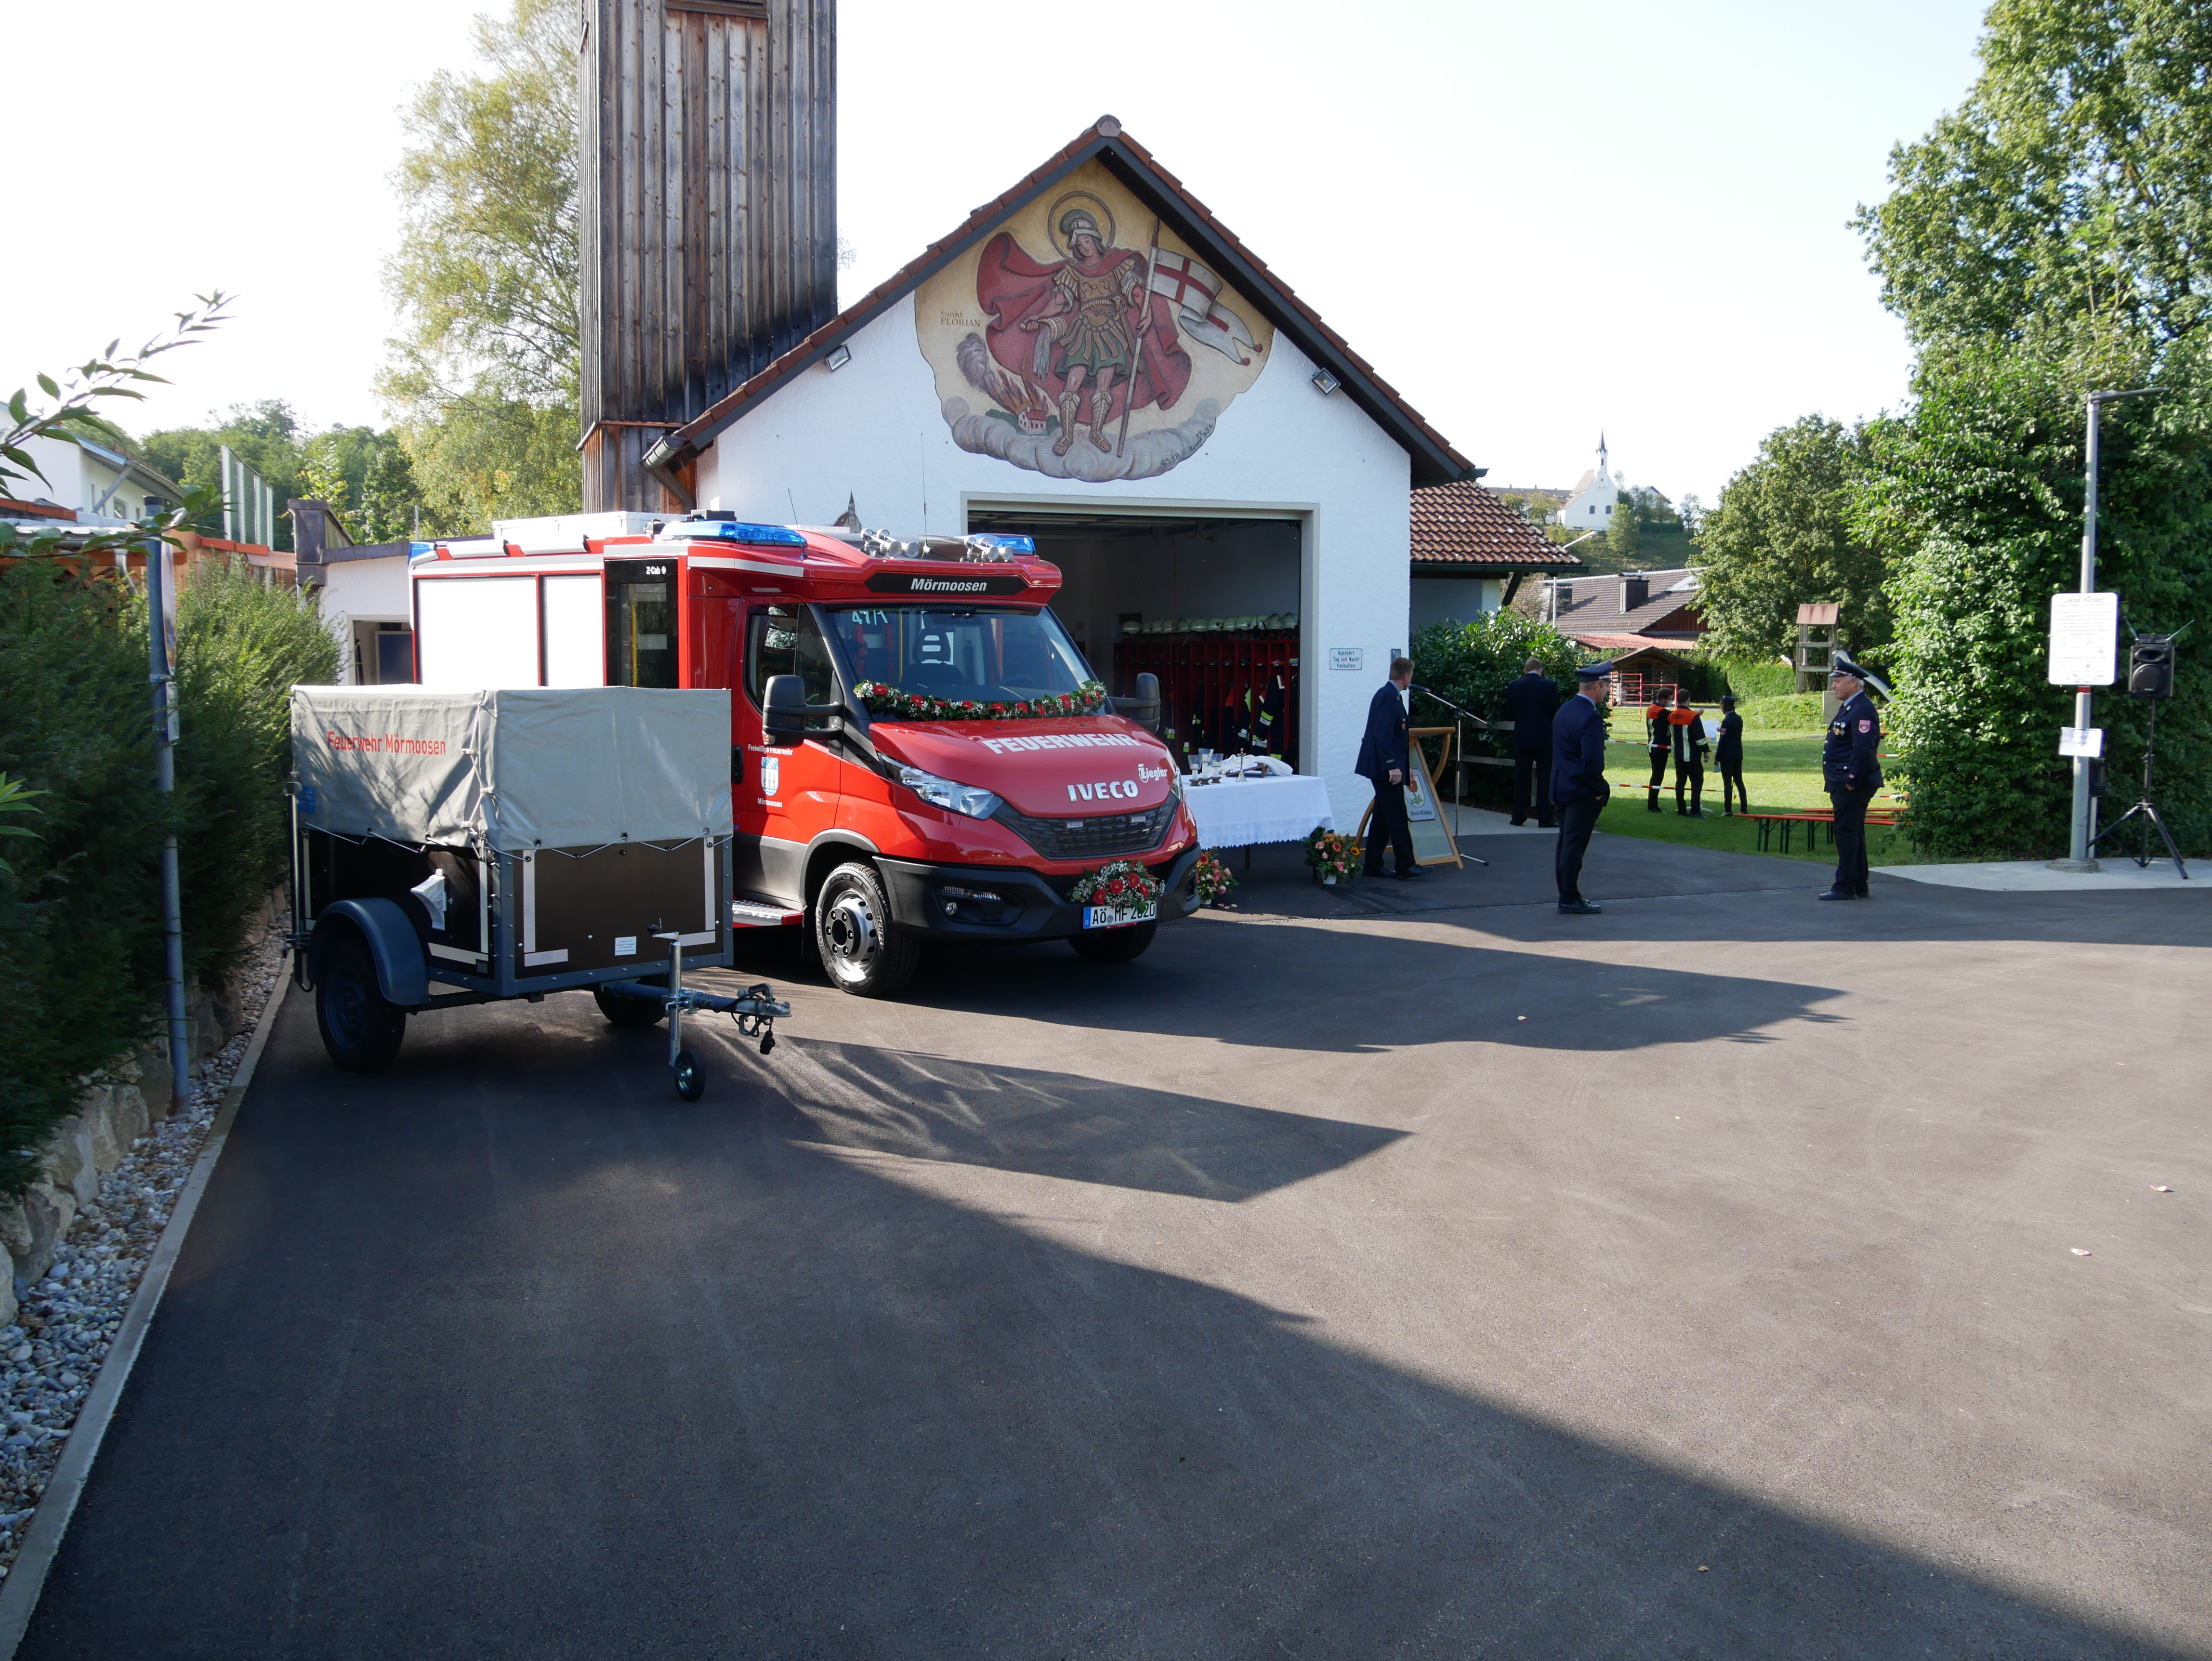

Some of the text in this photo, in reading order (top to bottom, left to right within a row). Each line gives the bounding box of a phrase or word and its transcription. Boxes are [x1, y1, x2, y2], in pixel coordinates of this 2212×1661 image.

[940, 310, 962, 318] Sankt
[941, 317, 980, 327] FLORIAN
[646, 566, 660, 575] Z-Cab
[910, 578, 988, 592] Mörmoosen
[328, 731, 446, 756] Feuerwehr Mörmoosen
[748, 744, 794, 756] Freiwillige Feuerwehr
[982, 733, 1142, 754] FEUERWEHR
[1067, 780, 1138, 802] IVECO
[757, 797, 783, 808] Mörmoosen
[1092, 908, 1106, 924] AÖ
[1114, 906, 1127, 922] MF
